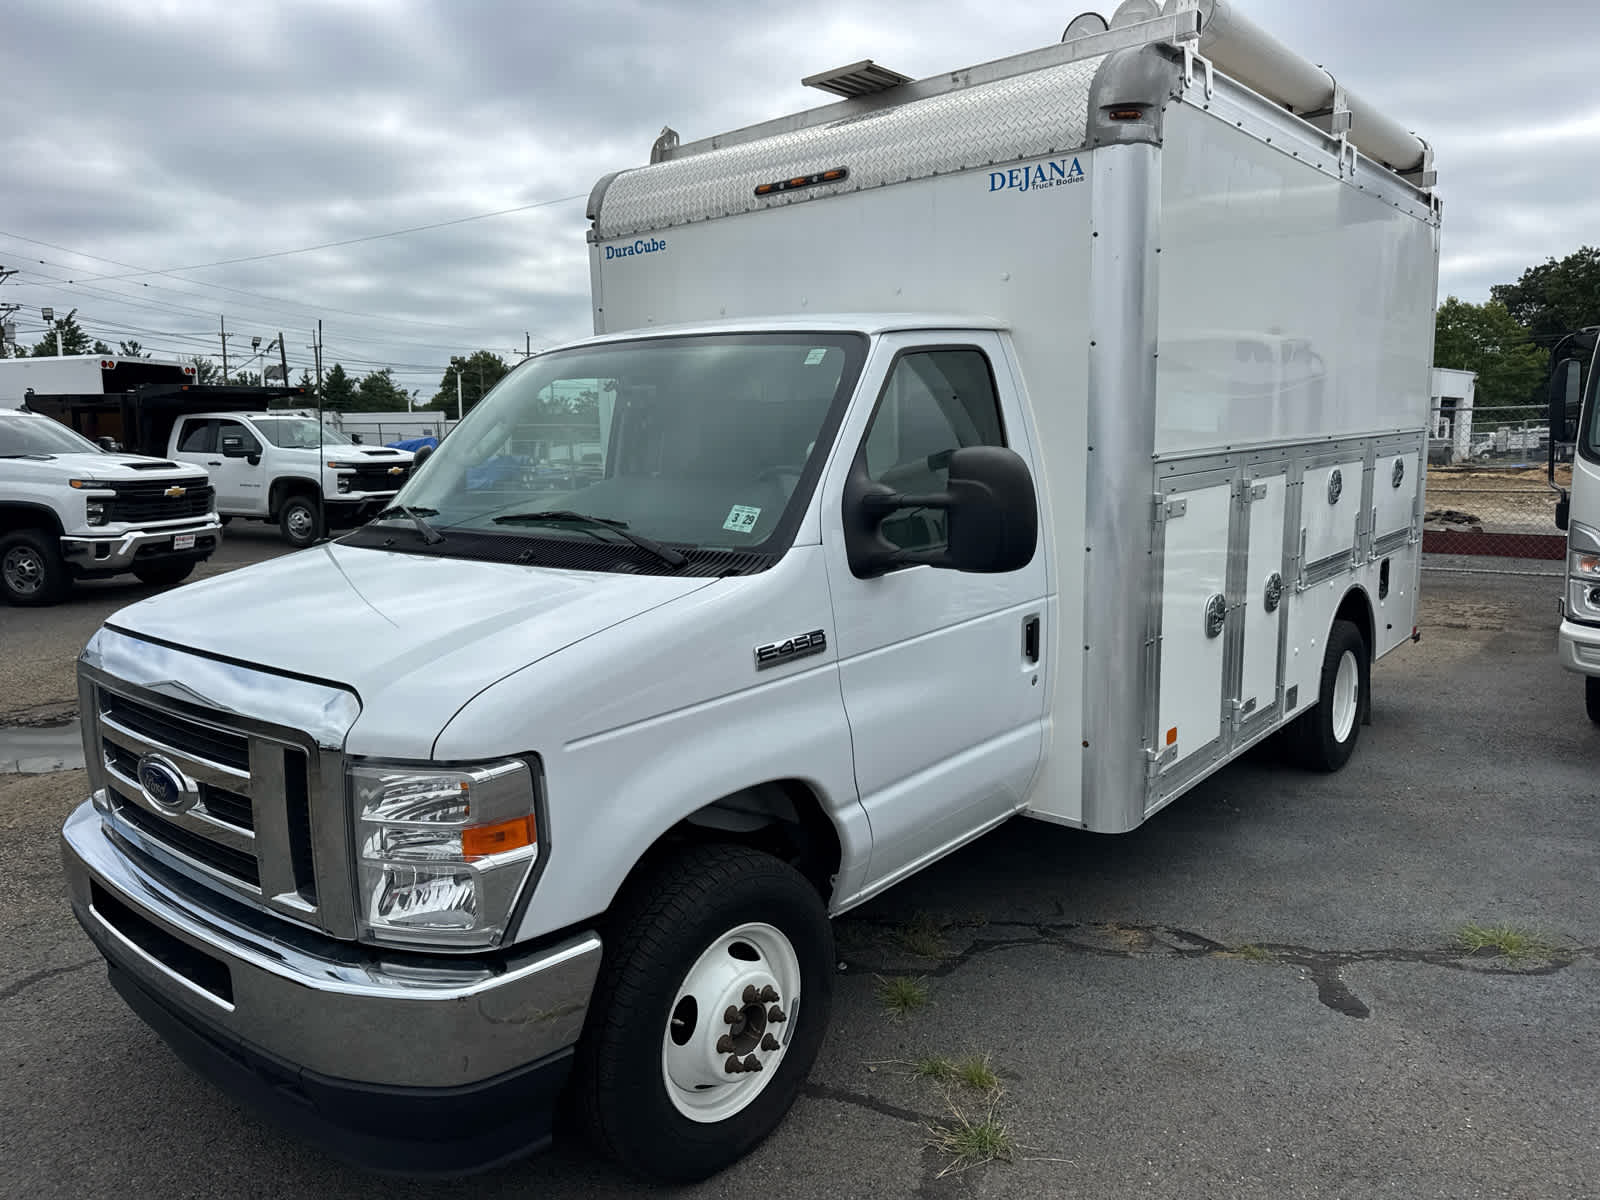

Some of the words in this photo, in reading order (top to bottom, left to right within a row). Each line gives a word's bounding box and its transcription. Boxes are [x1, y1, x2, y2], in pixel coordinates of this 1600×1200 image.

[989, 157, 1084, 192] DEJANA
[1032, 181, 1054, 190] Truck
[1056, 176, 1085, 186] Bodies
[605, 238, 667, 260] DuraCube
[731, 512, 740, 523] 3
[742, 514, 755, 525] 29
[755, 629, 826, 664] E-450
